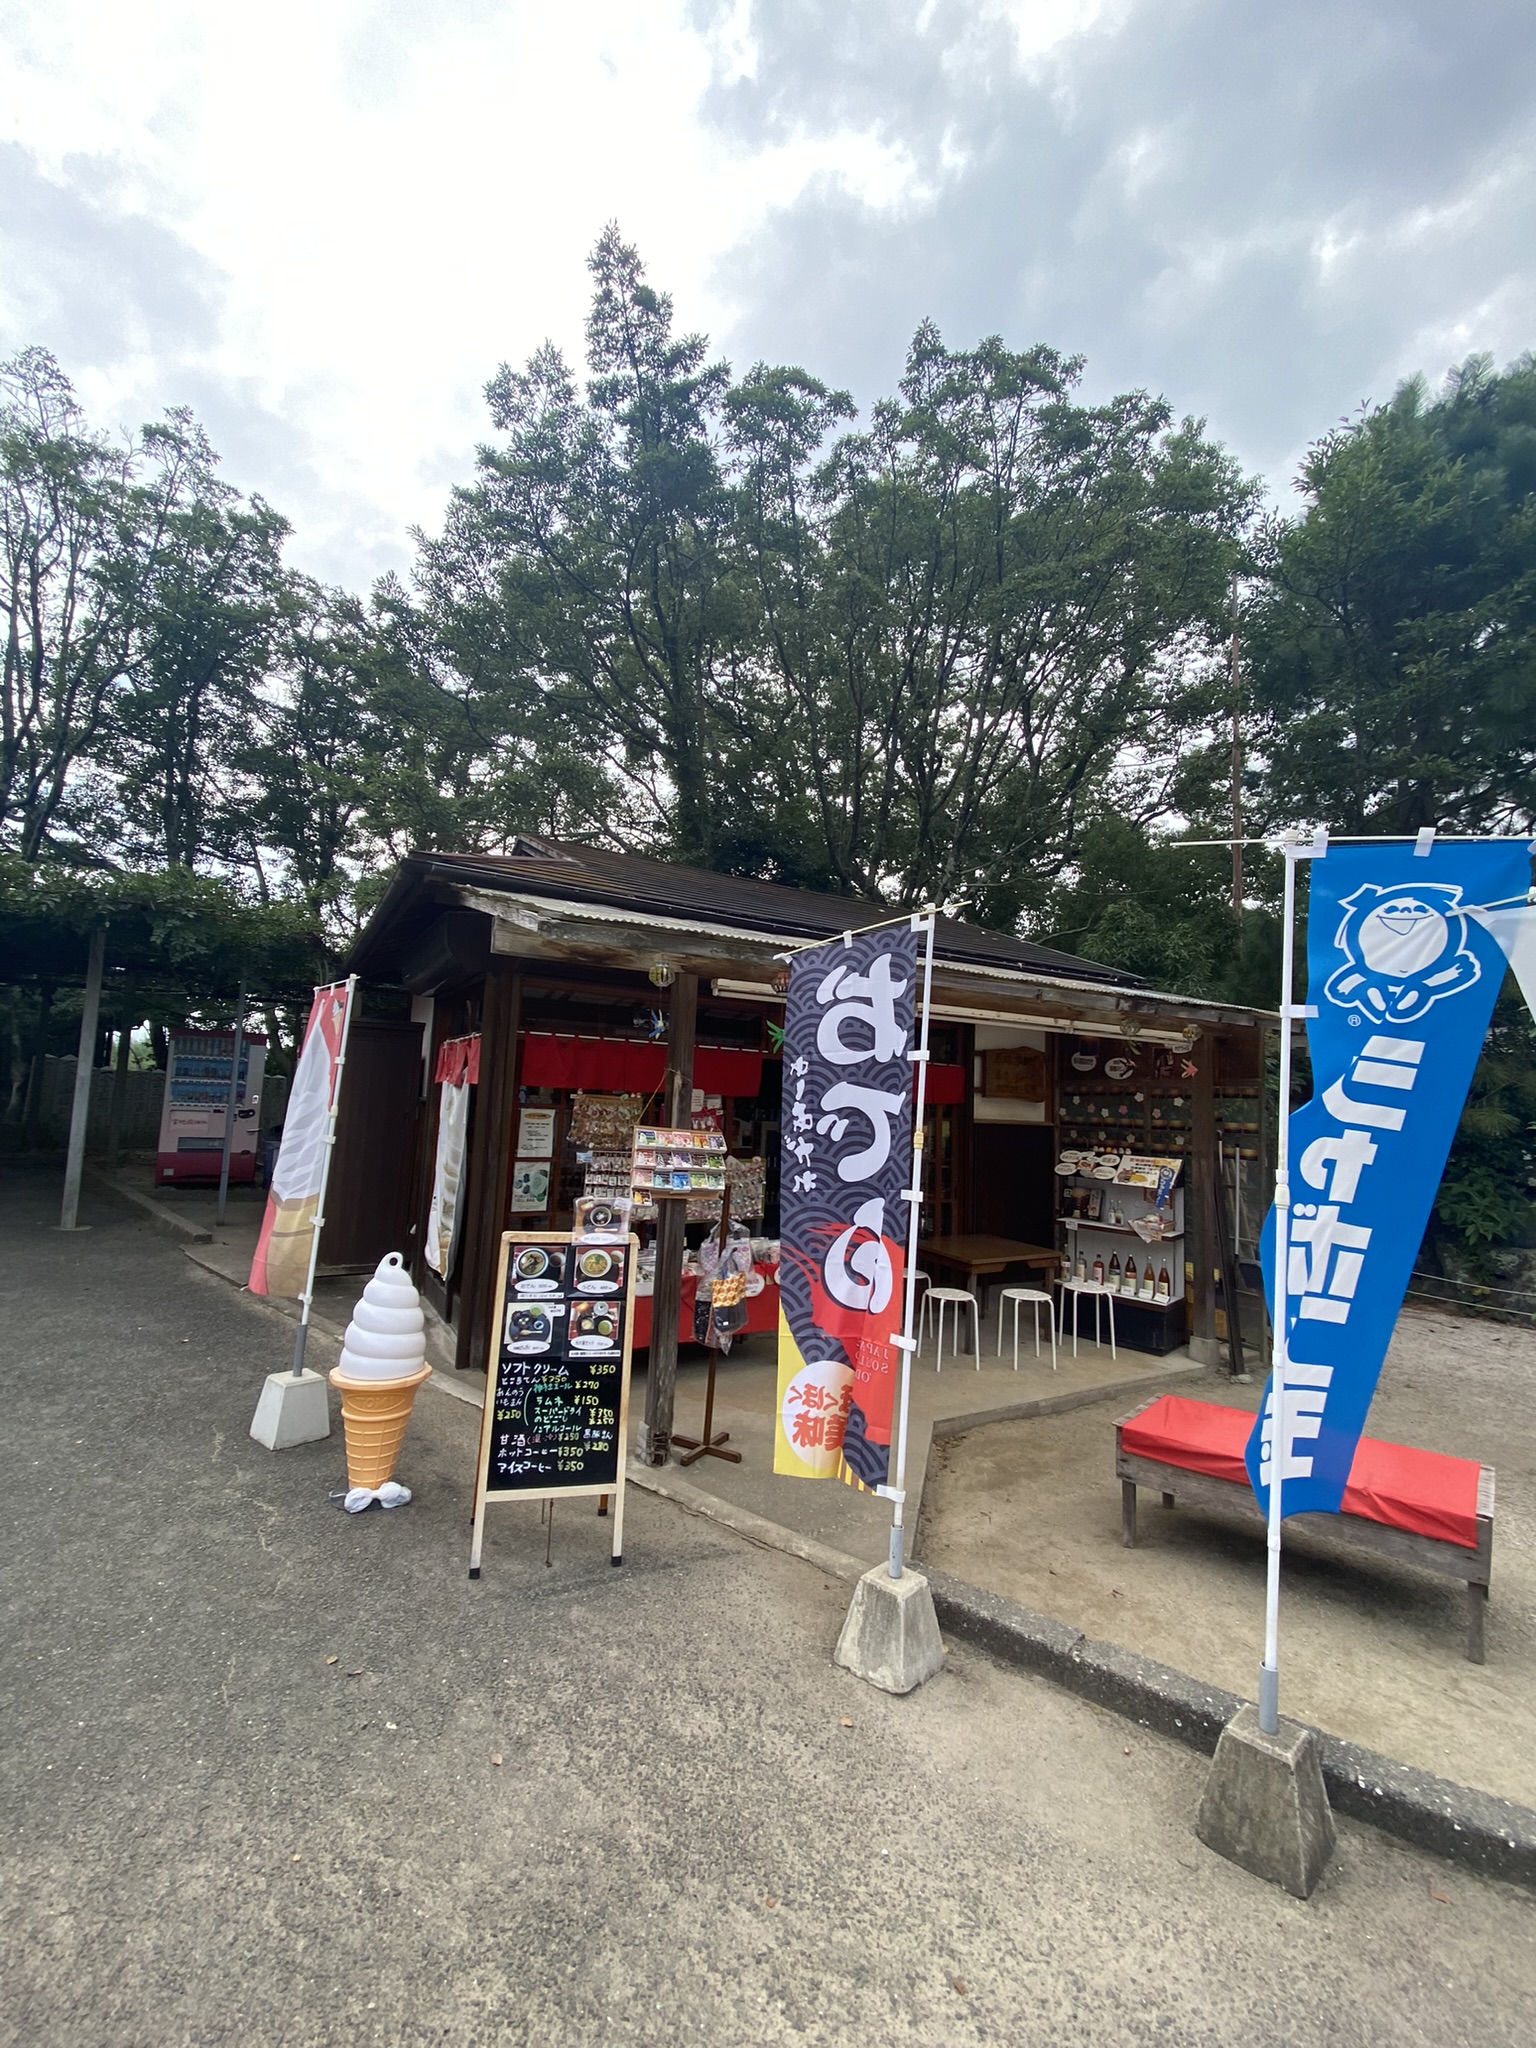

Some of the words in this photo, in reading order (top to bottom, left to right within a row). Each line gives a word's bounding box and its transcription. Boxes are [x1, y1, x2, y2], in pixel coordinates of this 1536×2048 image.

[501, 1361, 570, 1376] ソフトクリーム
[501, 1376, 541, 1386] ところてん
[536, 1396, 564, 1407] ラムネ
[534, 1406, 583, 1416] スーパードライ
[497, 1447, 558, 1458] ホットコーヒー
[496, 1460, 552, 1474] アイスコーヒー
